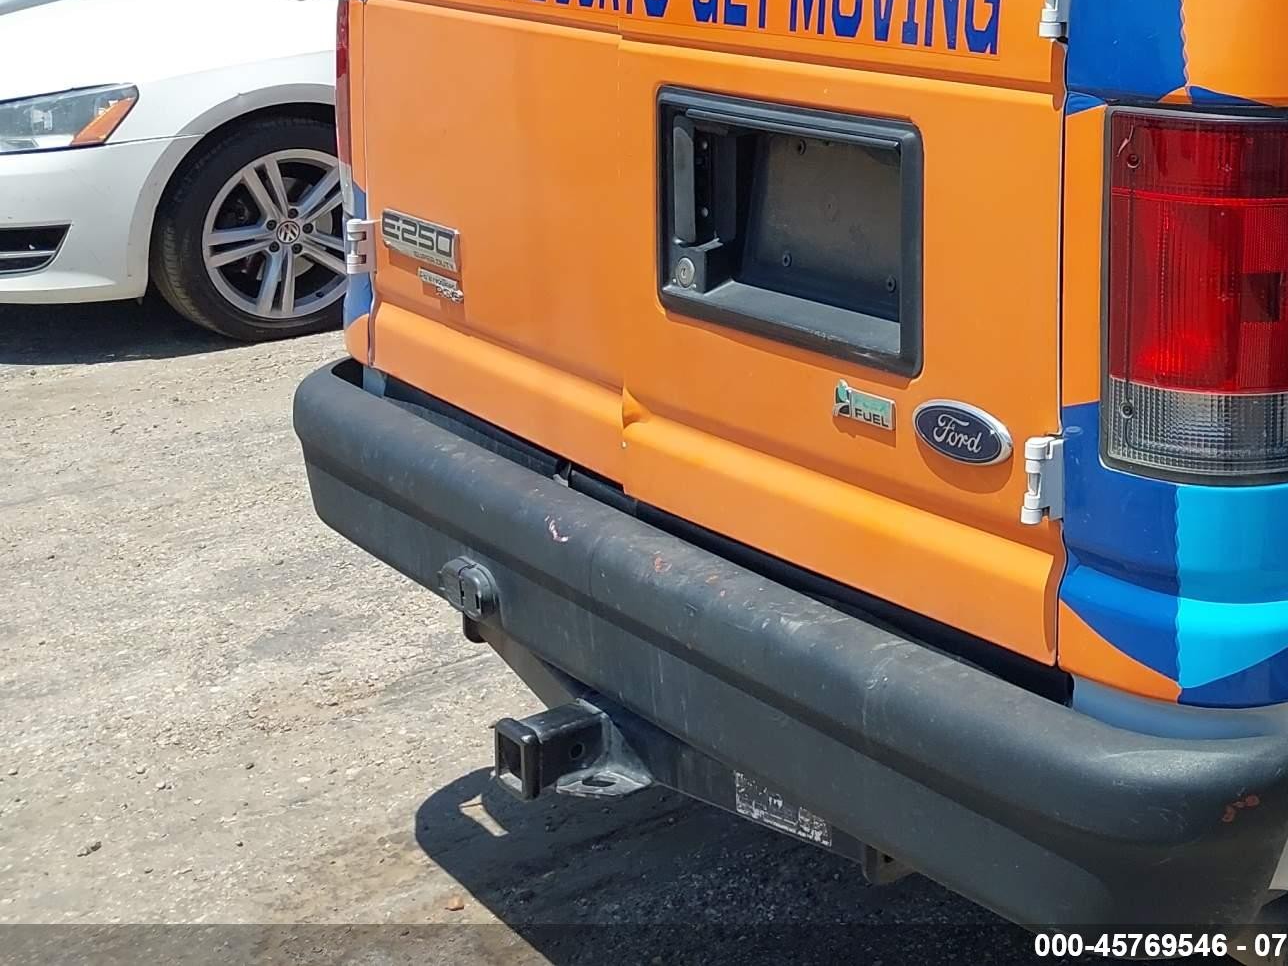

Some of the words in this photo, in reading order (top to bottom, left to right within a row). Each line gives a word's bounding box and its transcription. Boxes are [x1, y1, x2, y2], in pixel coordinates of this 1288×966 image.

[382, 213, 453, 258] E-250
[854, 408, 889, 428] FUEL
[933, 413, 983, 454] Ford
